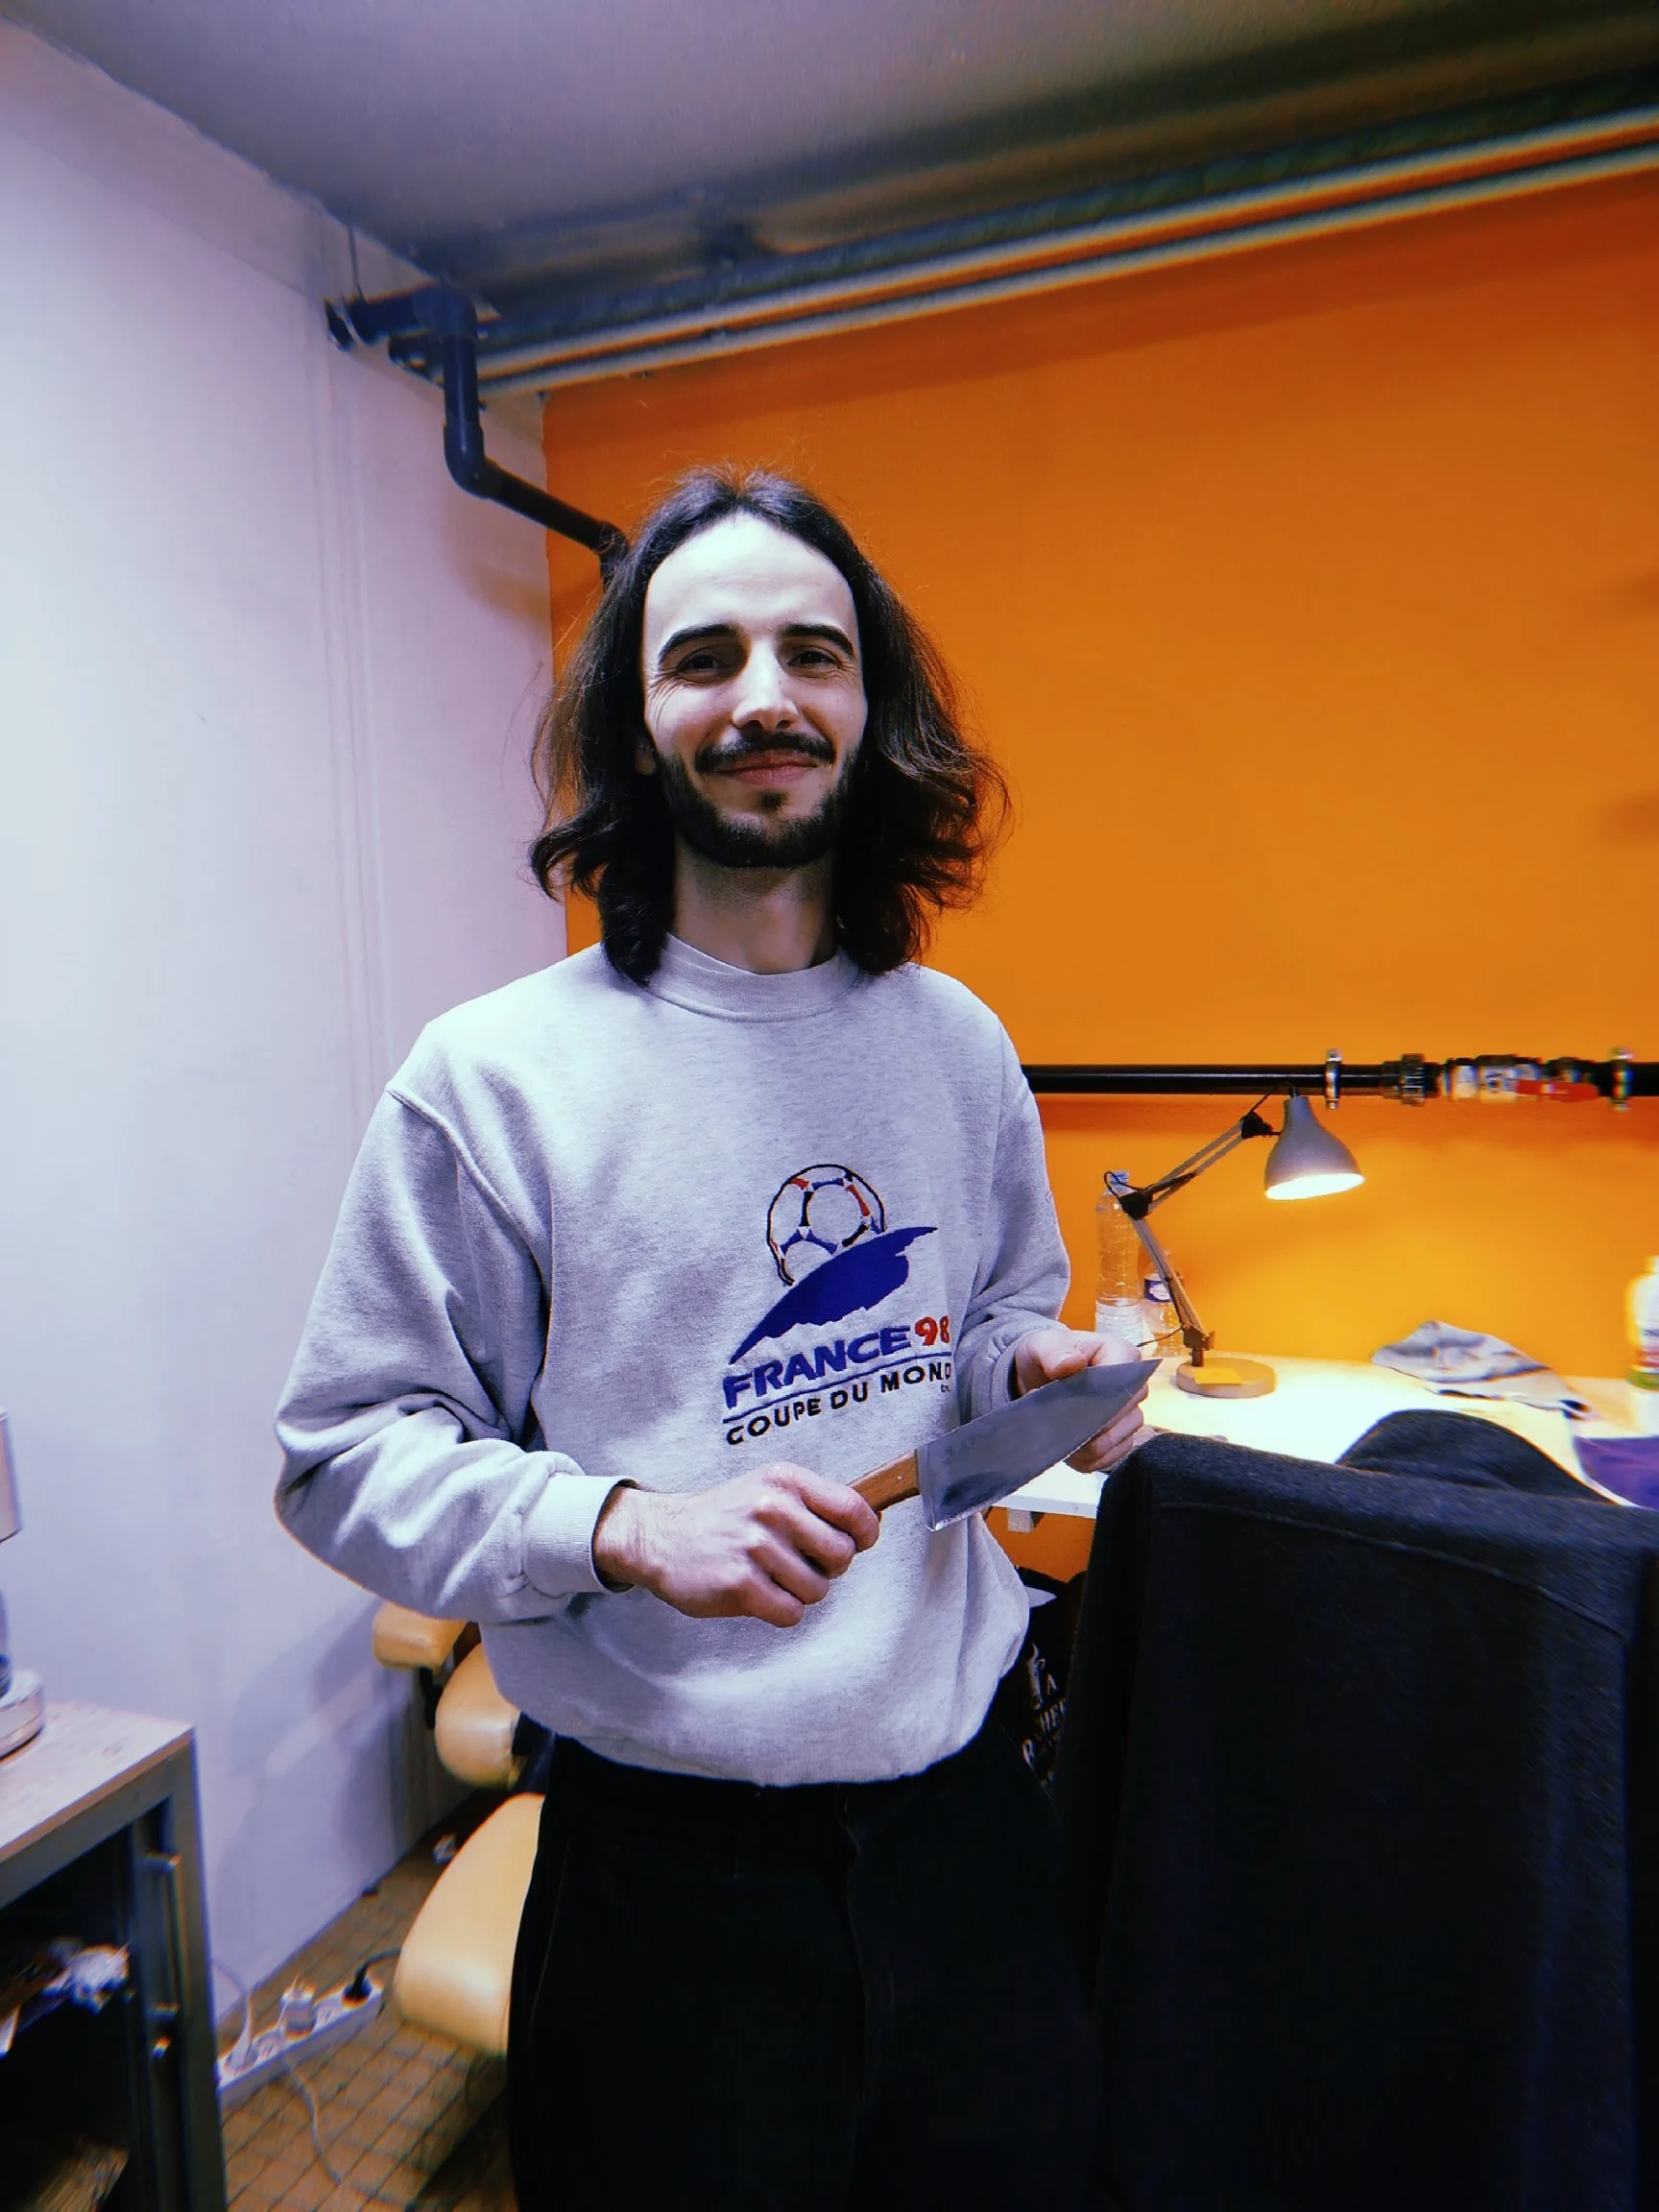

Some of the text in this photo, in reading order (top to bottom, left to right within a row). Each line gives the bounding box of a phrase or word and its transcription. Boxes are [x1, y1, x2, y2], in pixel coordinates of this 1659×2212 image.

[722, 1314, 951, 1410] FRANCE 98
[726, 1398, 822, 1446] COUPE
[830, 1381, 869, 1410] DU
